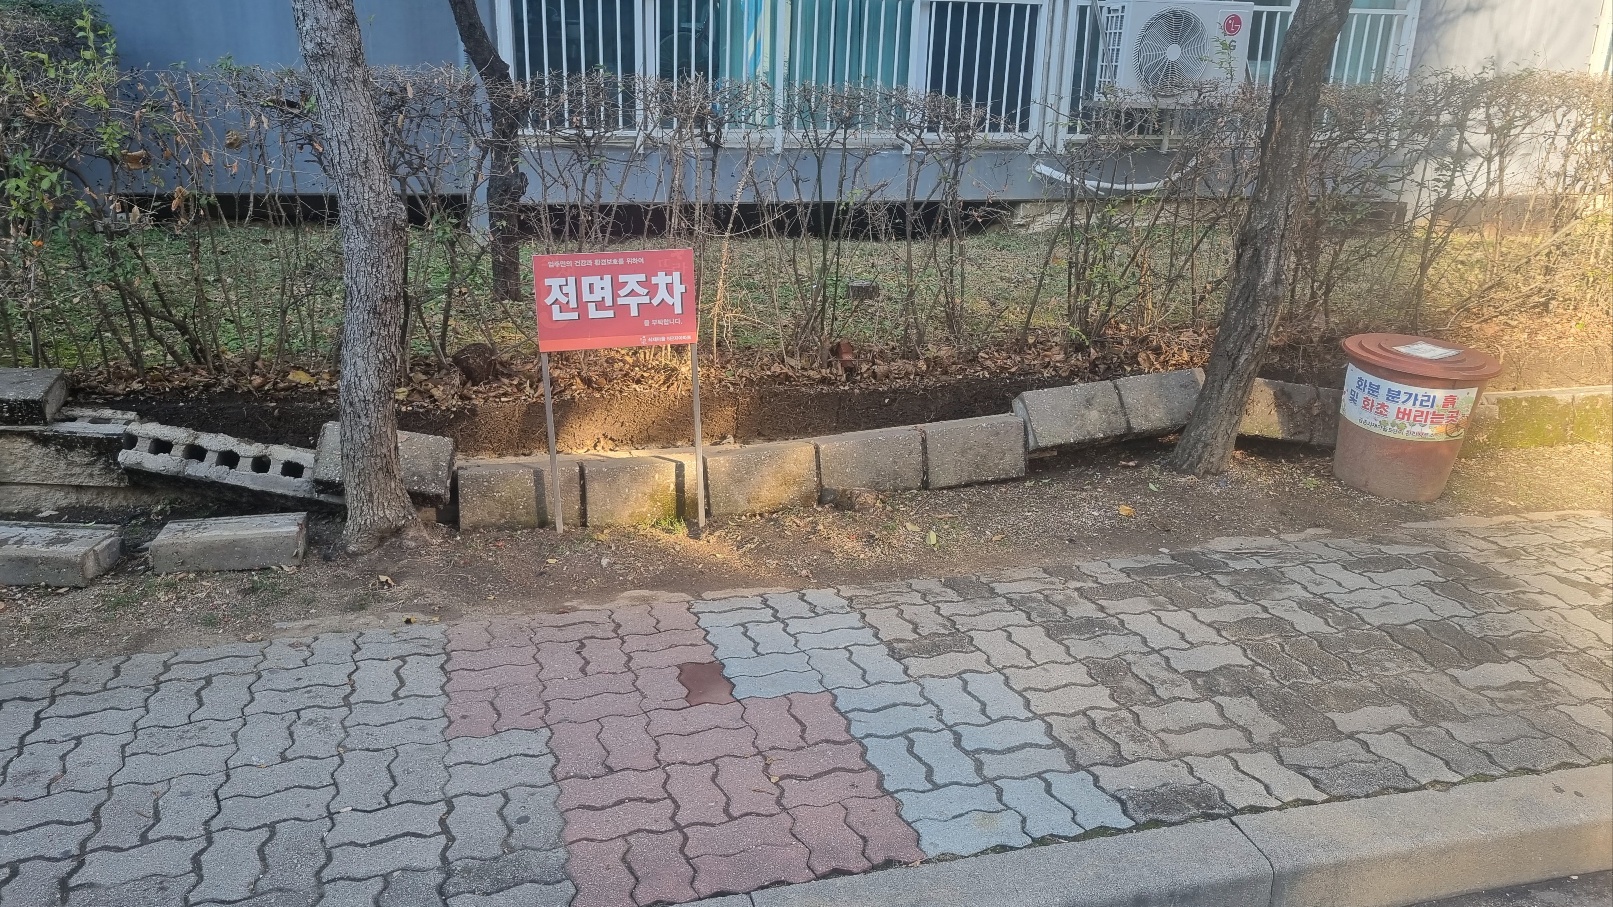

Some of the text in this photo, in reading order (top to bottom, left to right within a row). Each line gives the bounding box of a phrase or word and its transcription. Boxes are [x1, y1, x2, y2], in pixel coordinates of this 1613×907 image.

[547, 260, 573, 268] 입주민의
[574, 259, 593, 267] 건강과
[594, 258, 624, 266] 환경보호를
[544, 271, 686, 321] 전면주차
[1348, 389, 1460, 425] 및 화초 버리는곳
[1356, 377, 1458, 409] 화분 분가리 흙
